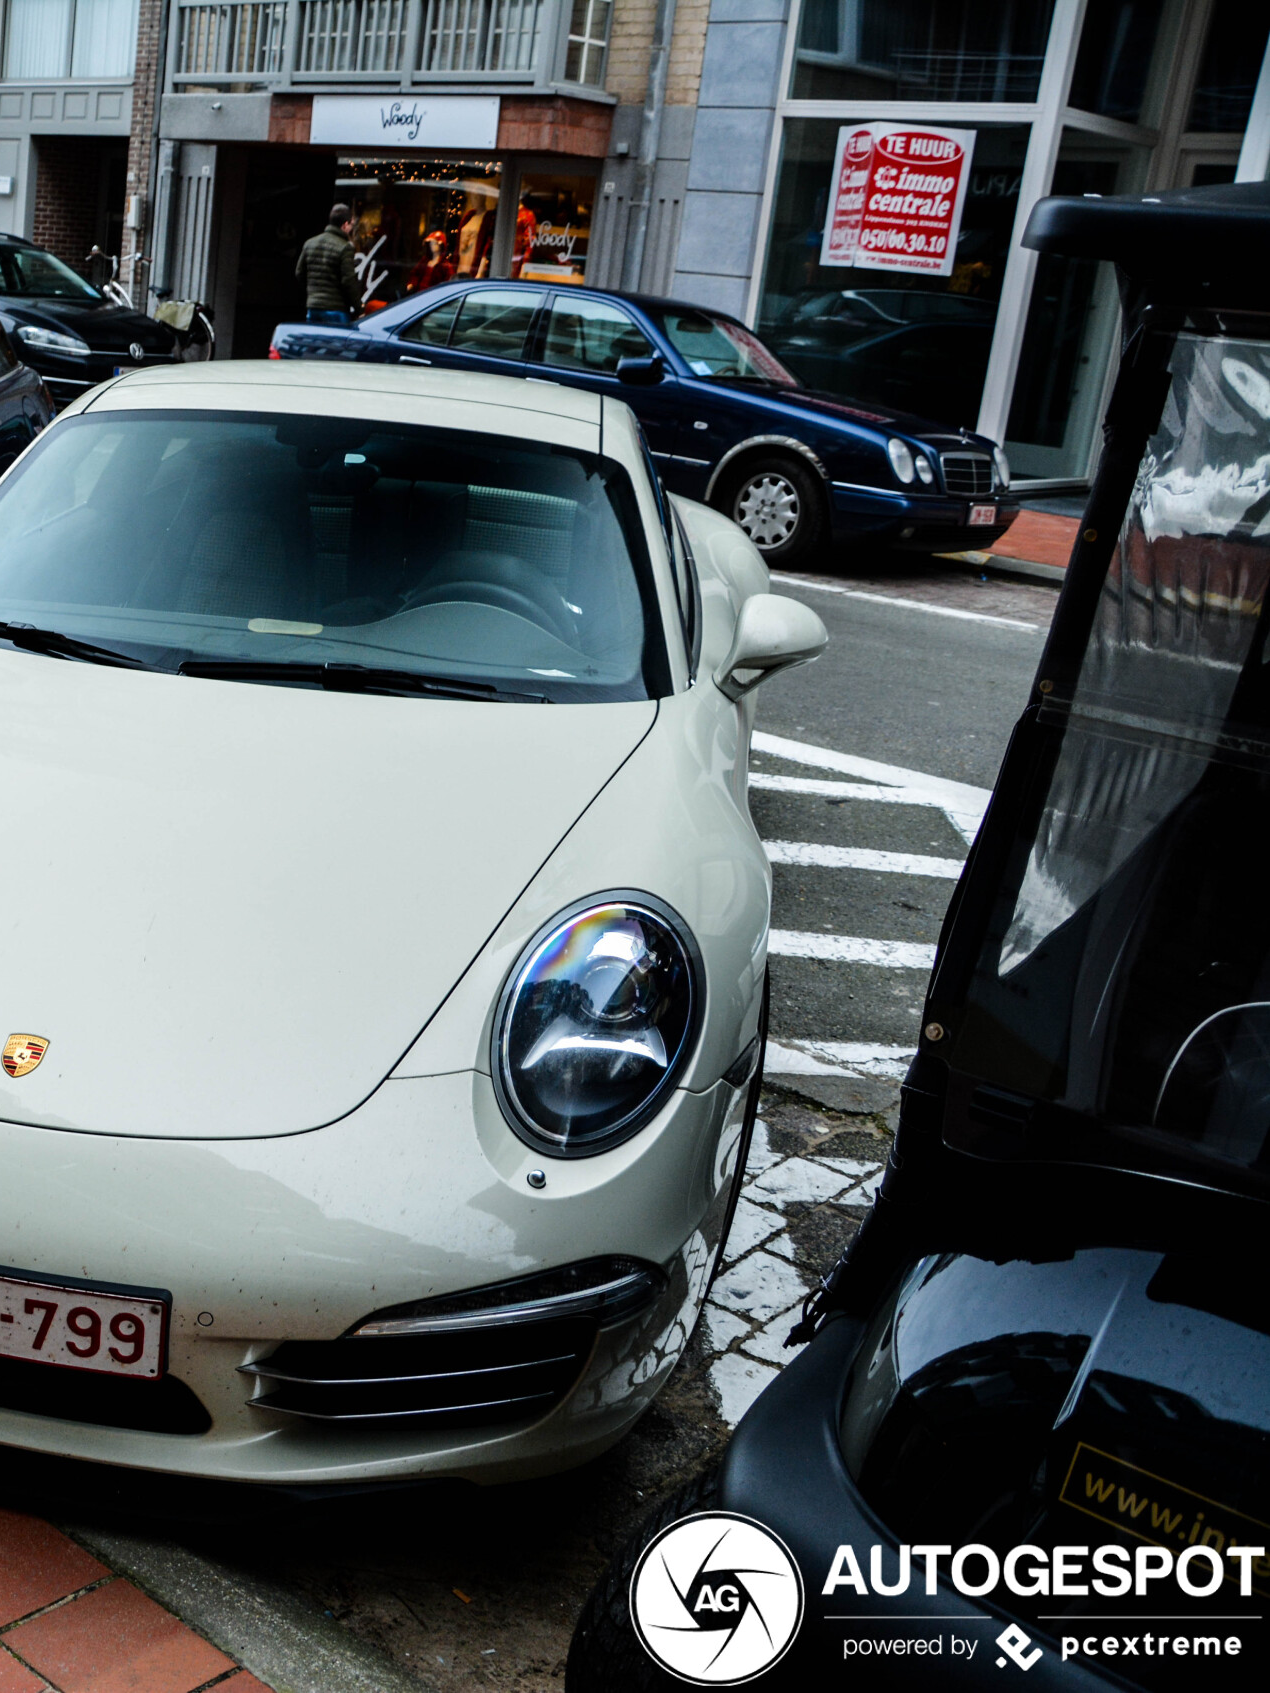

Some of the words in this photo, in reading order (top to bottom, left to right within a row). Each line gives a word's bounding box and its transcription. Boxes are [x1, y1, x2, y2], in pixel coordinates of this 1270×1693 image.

[380, 102, 423, 140] Woody
[886, 135, 907, 154] TE
[909, 137, 957, 159] HUUR
[895, 166, 955, 195] immo
[868, 192, 951, 218] centrale
[528, 220, 577, 263] Woody
